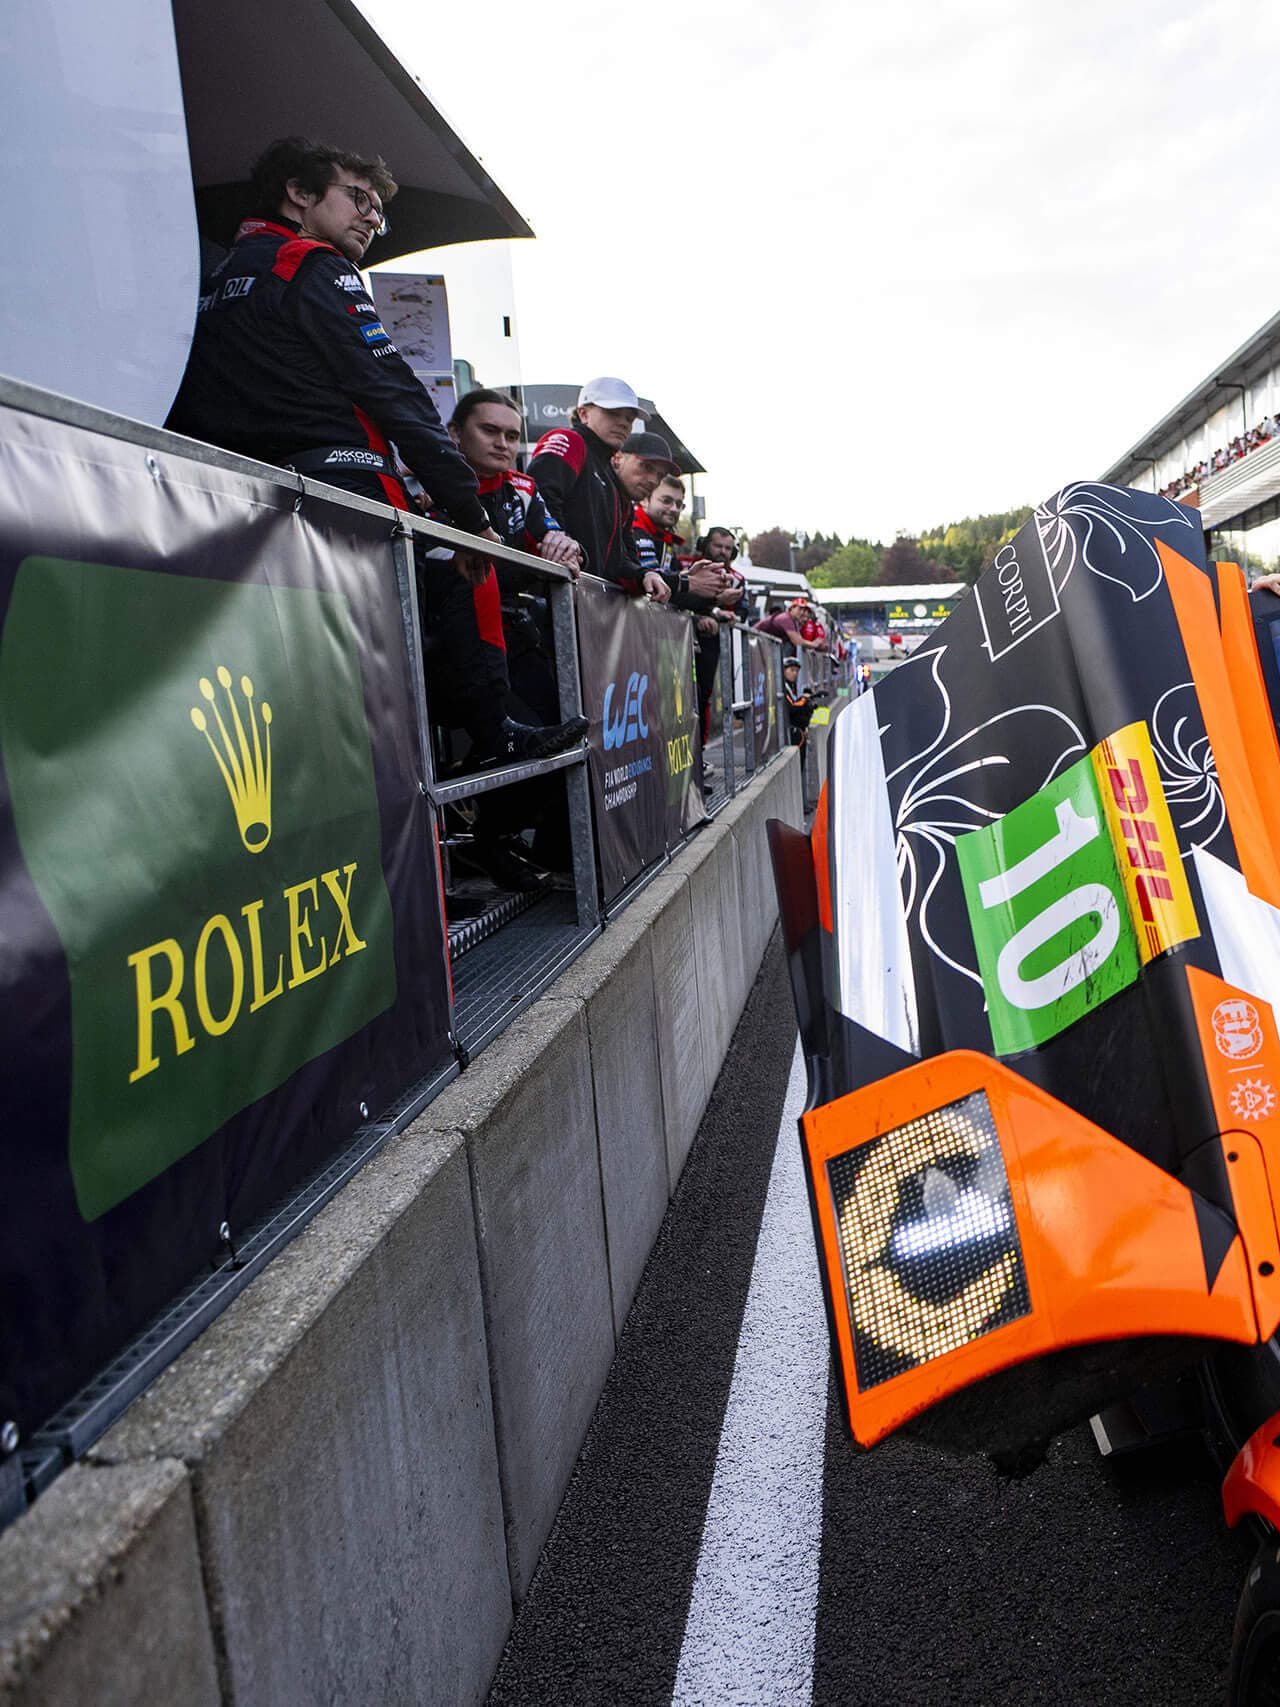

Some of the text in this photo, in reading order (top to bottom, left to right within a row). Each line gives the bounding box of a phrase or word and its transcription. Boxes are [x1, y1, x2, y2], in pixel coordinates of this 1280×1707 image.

[994, 538, 1032, 636] CORPII
[602, 671, 649, 751] WEC
[613, 766, 629, 787] WORLD
[1108, 759, 1174, 922] DHL
[978, 798, 1121, 1010] 10
[127, 861, 368, 1085] ROLEX
